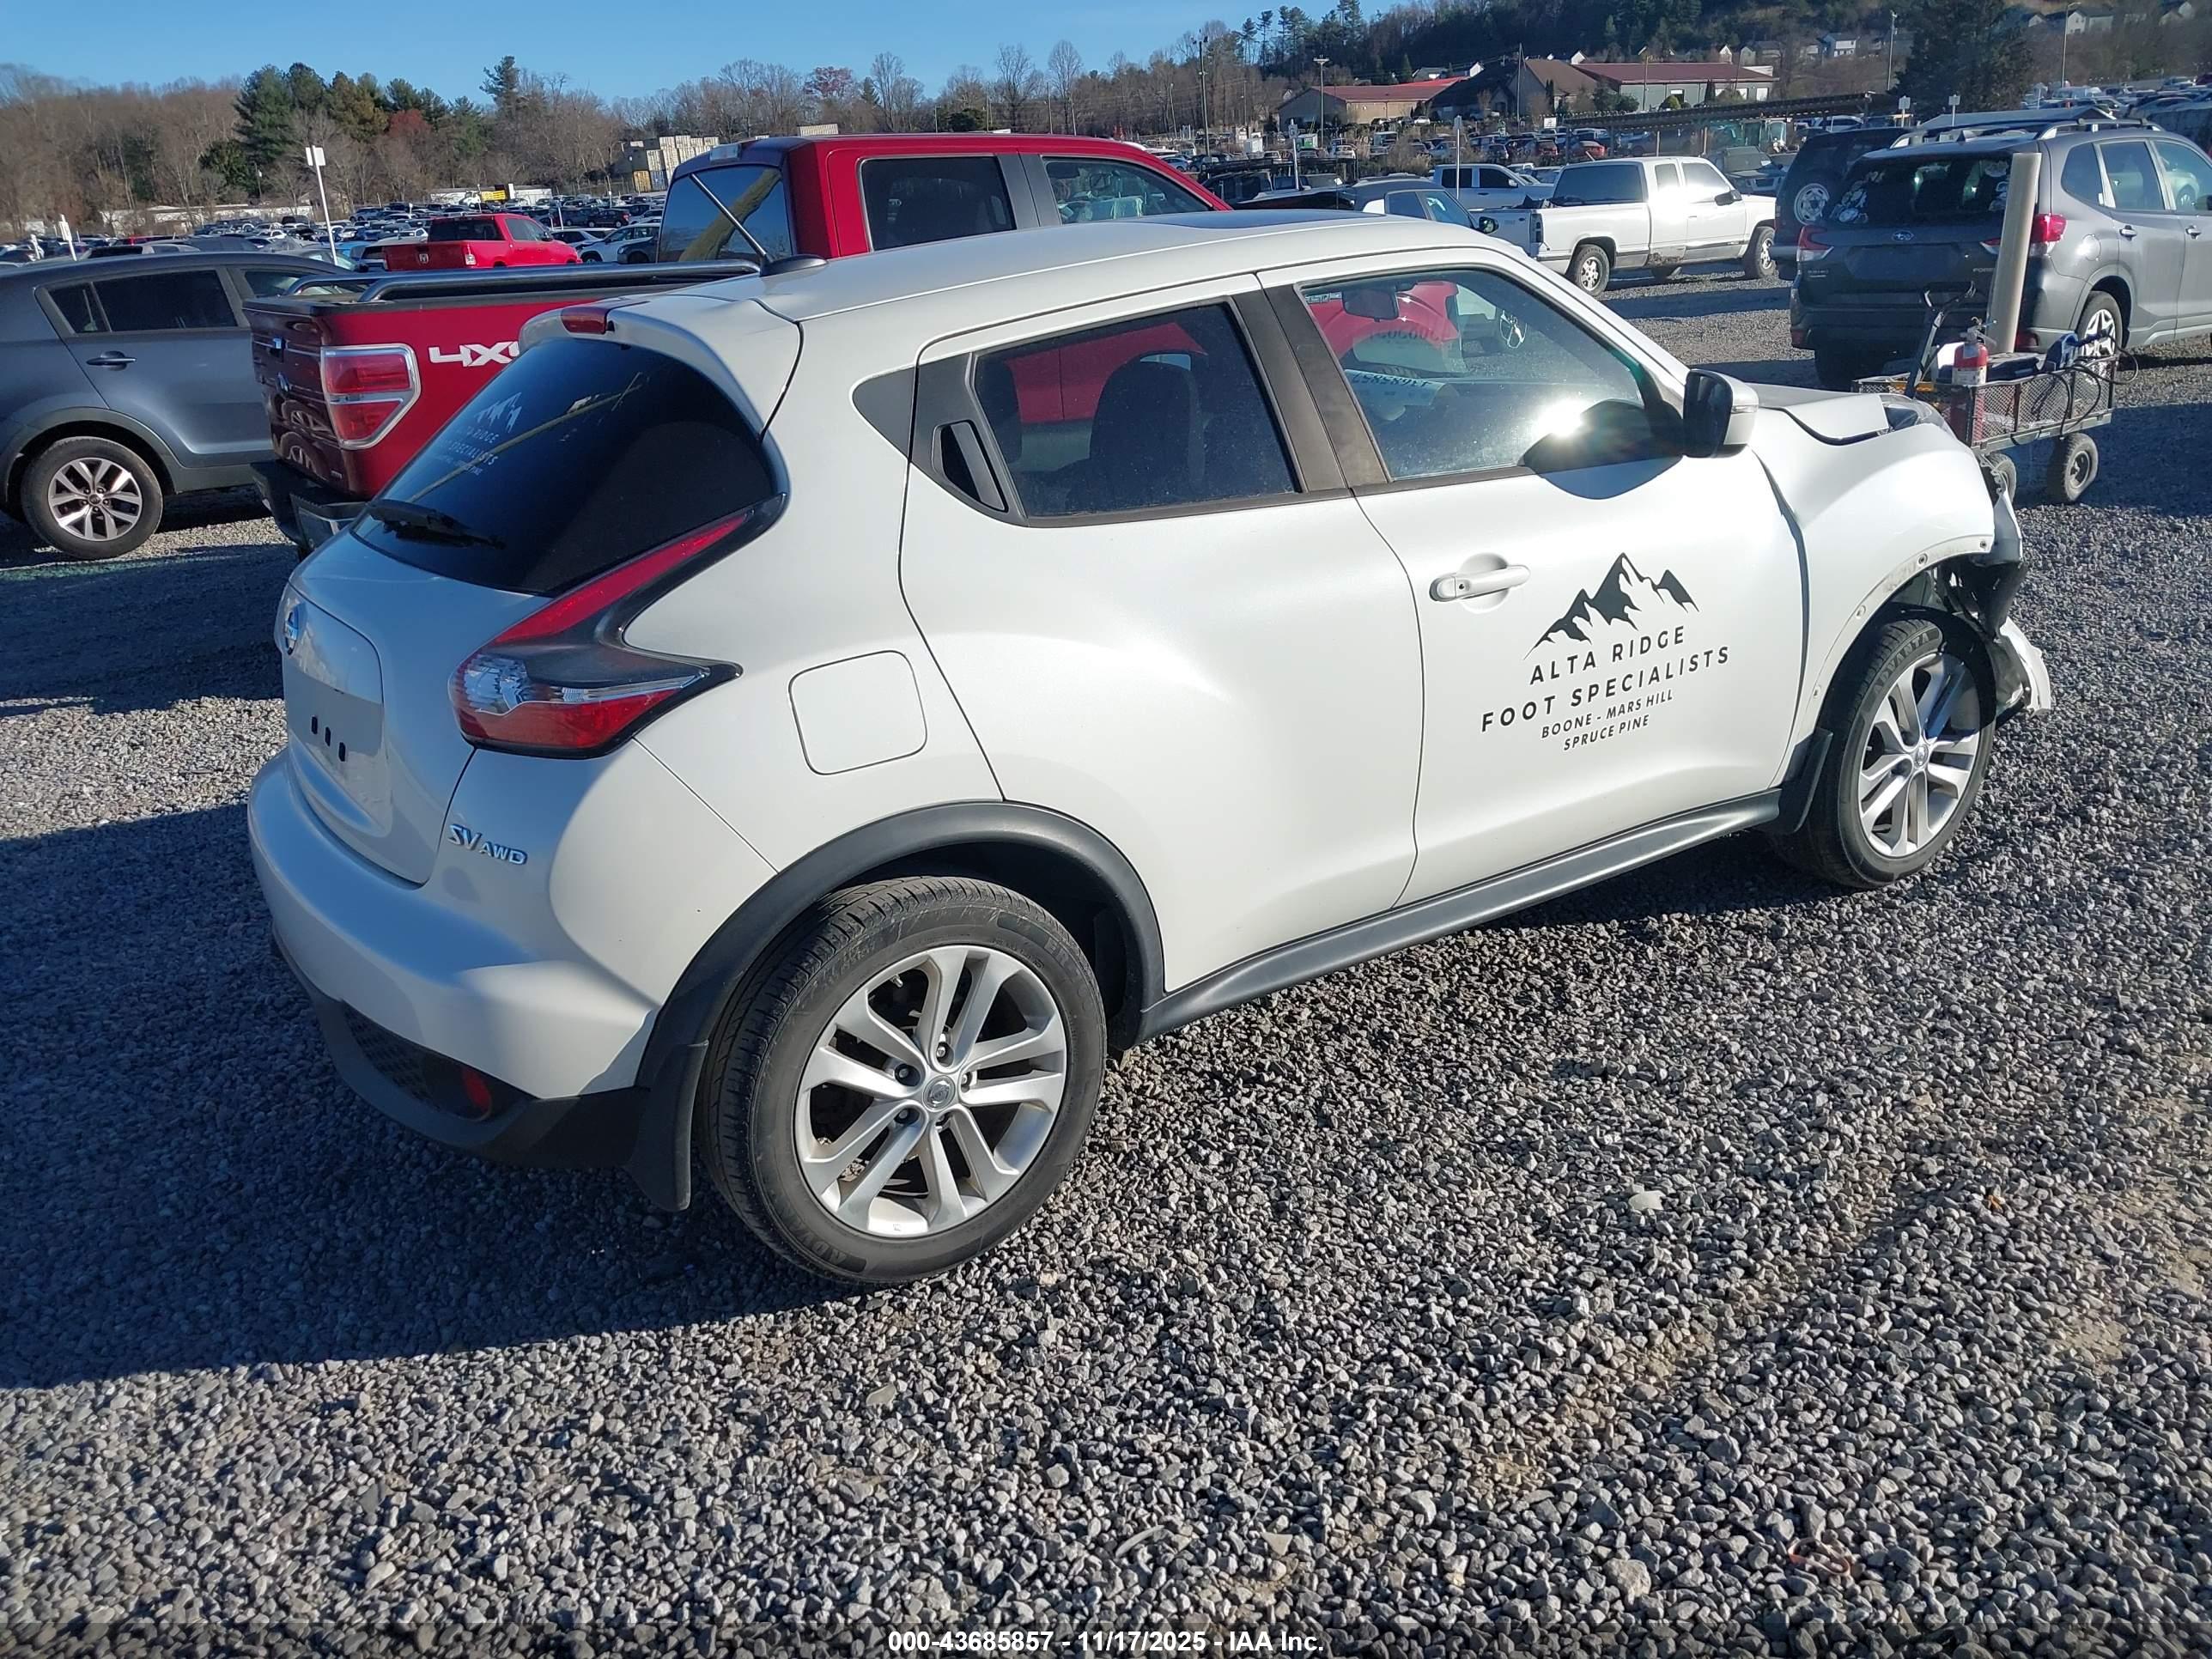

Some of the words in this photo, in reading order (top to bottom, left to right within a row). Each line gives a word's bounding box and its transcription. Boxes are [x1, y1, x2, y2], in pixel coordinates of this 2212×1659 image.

[1529, 651, 1596, 685] ALTA
[1612, 626, 1684, 662] RIDGE
[1481, 696, 1555, 732] FOOT
[1571, 647, 1729, 707] SPECIALISTS
[1541, 713, 1592, 738] BOONE
[1606, 699, 1642, 720] MARS
[1646, 690, 1673, 708] HILL
[1564, 725, 1613, 750] SPRUCE
[1619, 714, 1650, 734] PINE
[447, 823, 482, 850] SV
[479, 842, 528, 865] AWD
